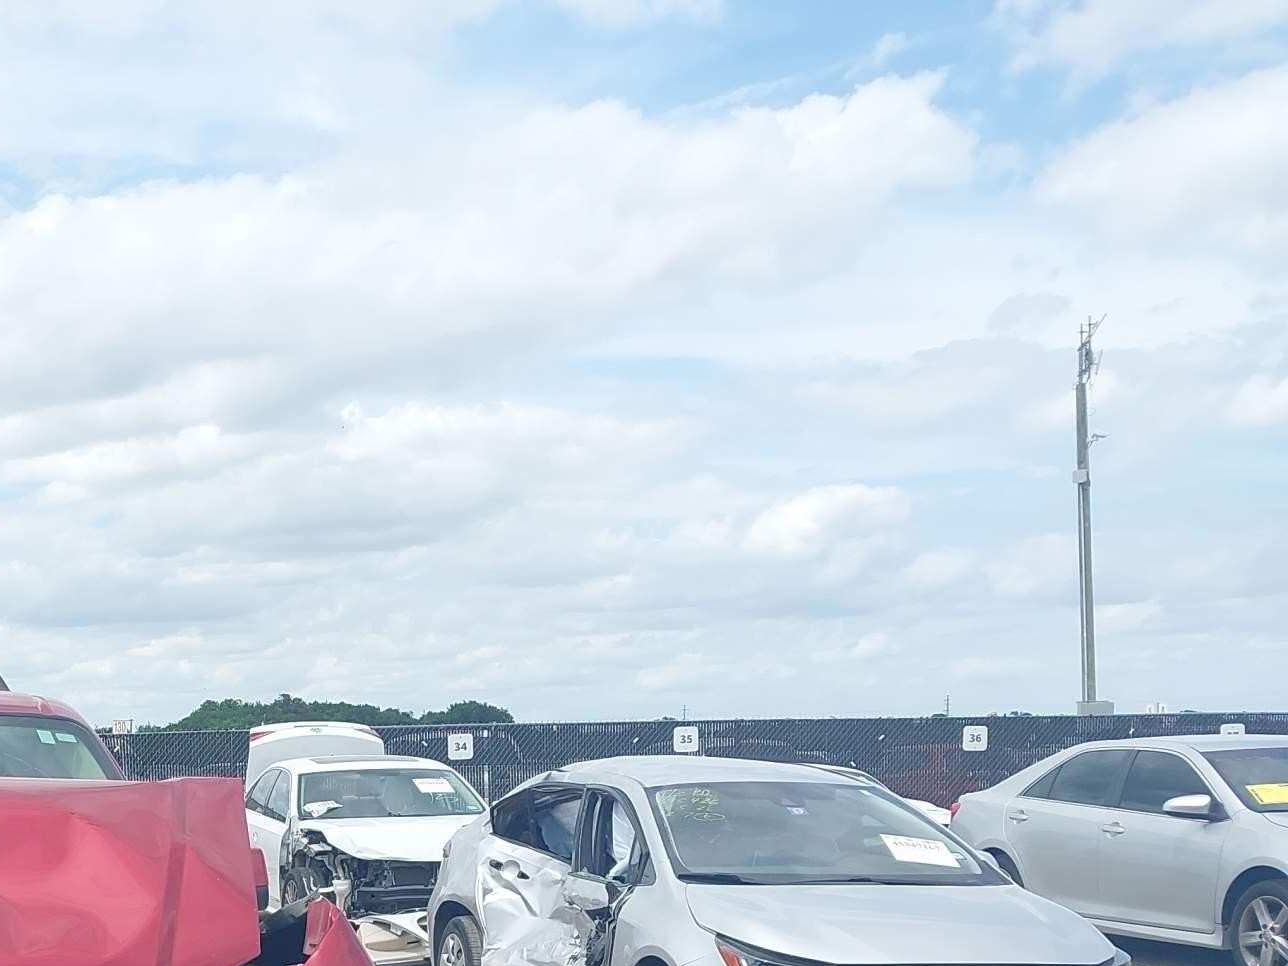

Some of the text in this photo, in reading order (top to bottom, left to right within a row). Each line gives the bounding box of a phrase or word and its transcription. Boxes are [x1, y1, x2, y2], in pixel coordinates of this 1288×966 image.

[680, 734, 693, 744] 35
[969, 733, 982, 743] 36
[454, 742, 467, 752] 34
